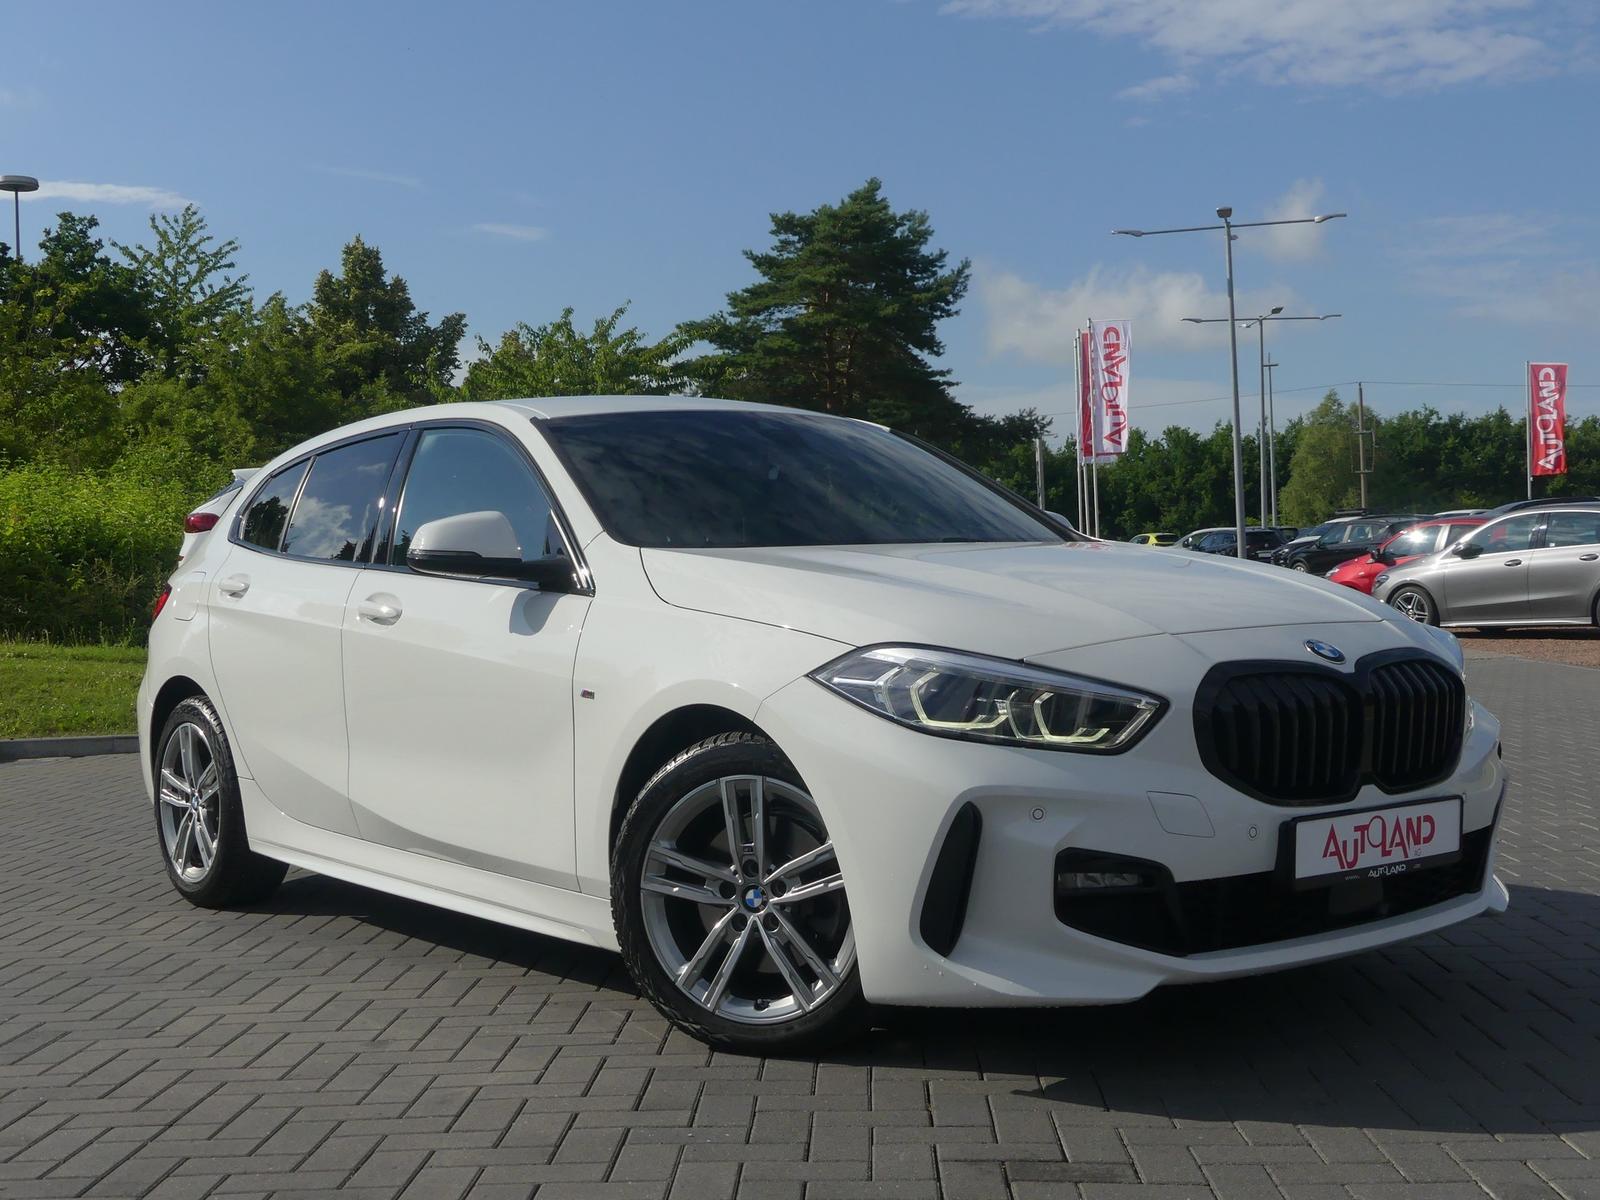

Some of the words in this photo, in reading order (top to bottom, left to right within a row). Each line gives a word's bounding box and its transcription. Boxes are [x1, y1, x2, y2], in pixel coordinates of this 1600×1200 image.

[1101, 326, 1127, 446] AUTOLAND
[1536, 367, 1563, 470] AUTOLAND
[1322, 815, 1436, 870] AUTOLAND
[1368, 864, 1406, 878] AUTOLAND
